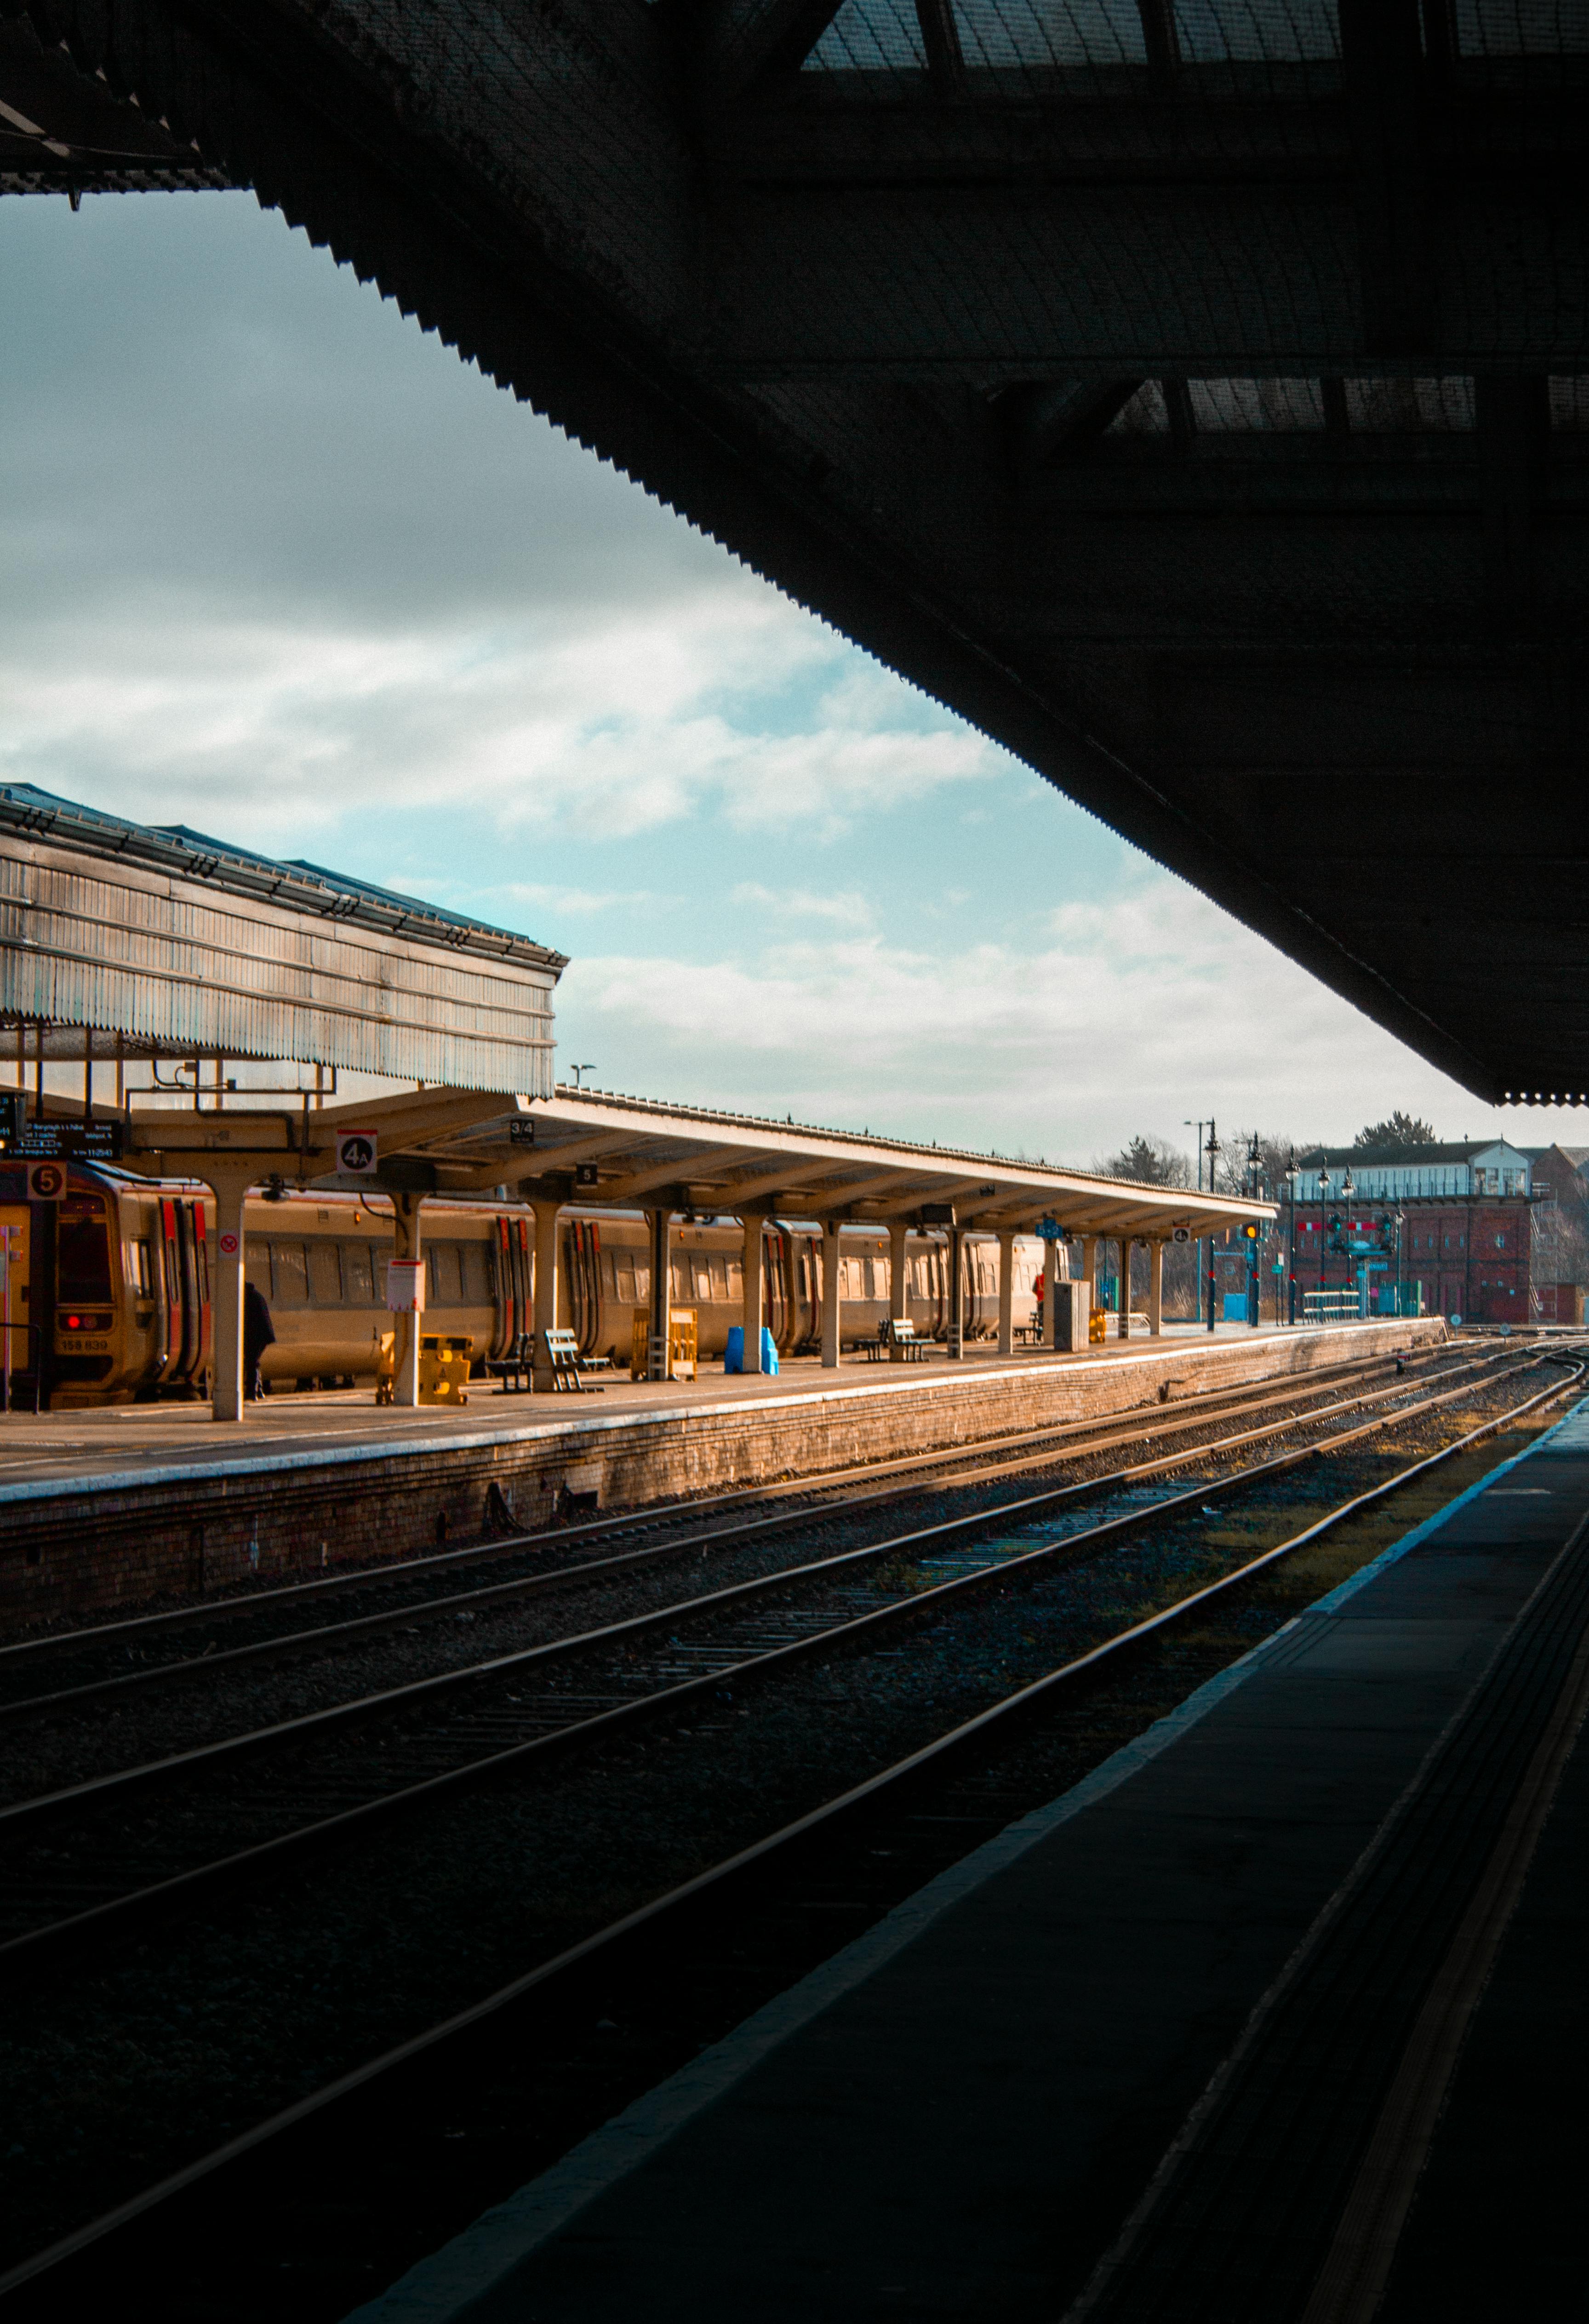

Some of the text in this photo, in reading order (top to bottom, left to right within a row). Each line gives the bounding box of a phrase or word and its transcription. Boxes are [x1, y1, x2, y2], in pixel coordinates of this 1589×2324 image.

[512, 1122, 532, 1134] 3/4
[345, 1143, 368, 1164] 4A
[40, 1170, 53, 1192] 5
[583, 1169, 591, 1181] 5
